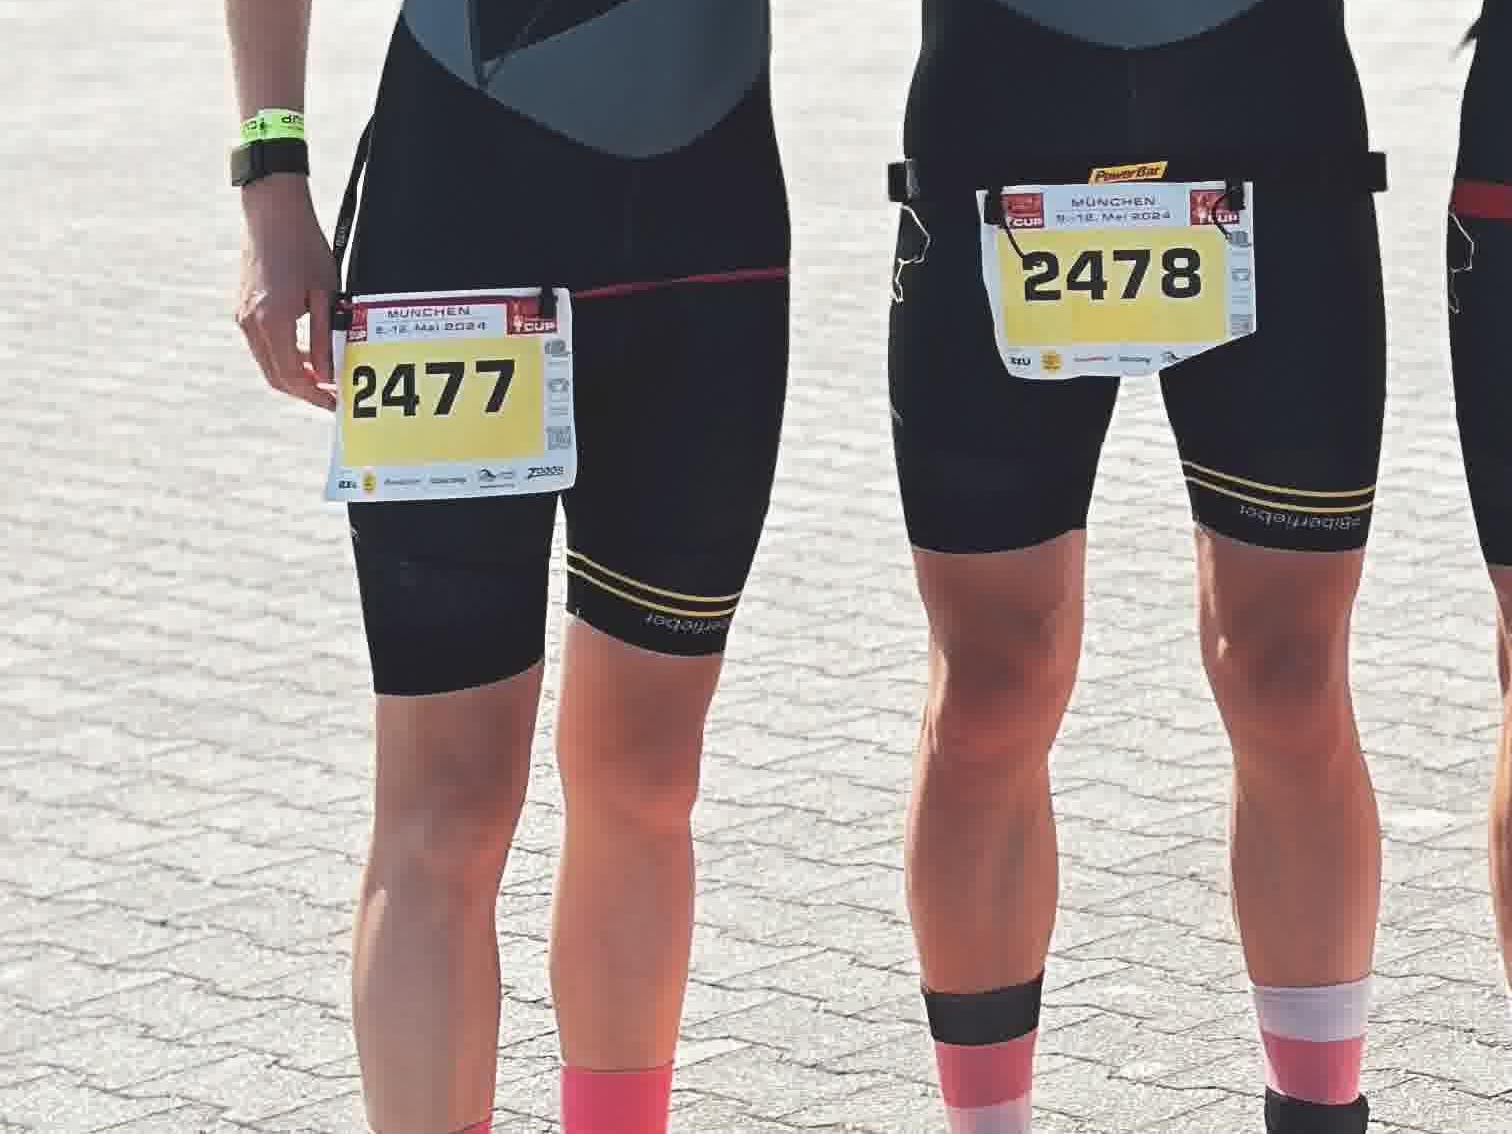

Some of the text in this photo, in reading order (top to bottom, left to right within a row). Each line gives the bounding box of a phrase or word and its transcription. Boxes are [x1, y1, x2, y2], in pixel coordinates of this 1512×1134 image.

[1071, 197, 1156, 209] MÜNCHEN
[1131, 211, 1171, 222] 2024
[1022, 248, 1202, 302] 2478
[444, 320, 488, 333] 2024
[352, 358, 516, 419] 2477
